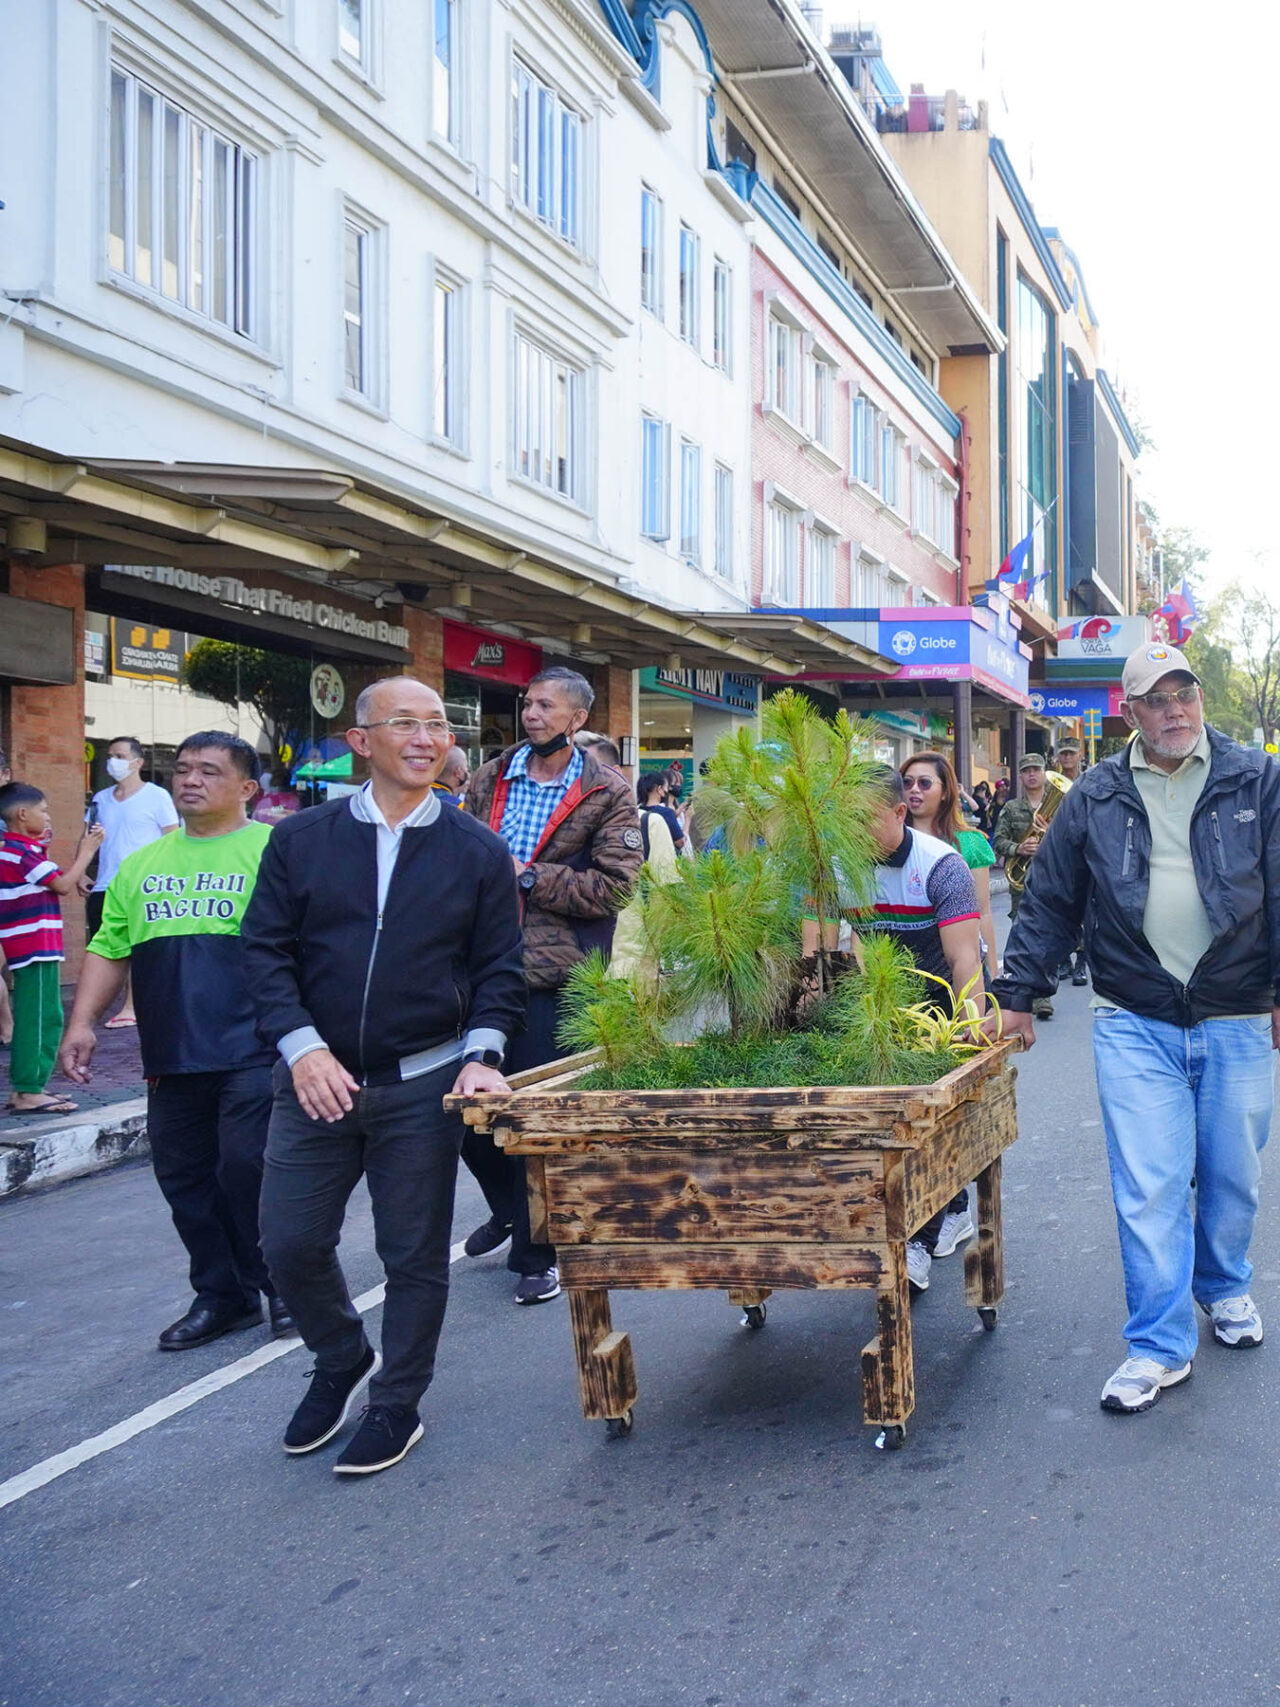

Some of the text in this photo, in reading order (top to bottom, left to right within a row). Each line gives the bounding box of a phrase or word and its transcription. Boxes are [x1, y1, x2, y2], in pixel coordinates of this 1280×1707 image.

[156, 567, 220, 597] House
[215, 577, 266, 611] That
[268, 589, 313, 623] Fried
[316, 604, 376, 640] Chicken
[376, 620, 410, 649] Built
[471, 642, 503, 667] Max's
[919, 637, 957, 649] Globe
[1081, 643, 1112, 653] VAGA
[696, 669, 725, 697] NAVY
[1047, 697, 1078, 708] Globe
[143, 872, 246, 896] City Hall
[145, 898, 234, 922] BAGUIO
